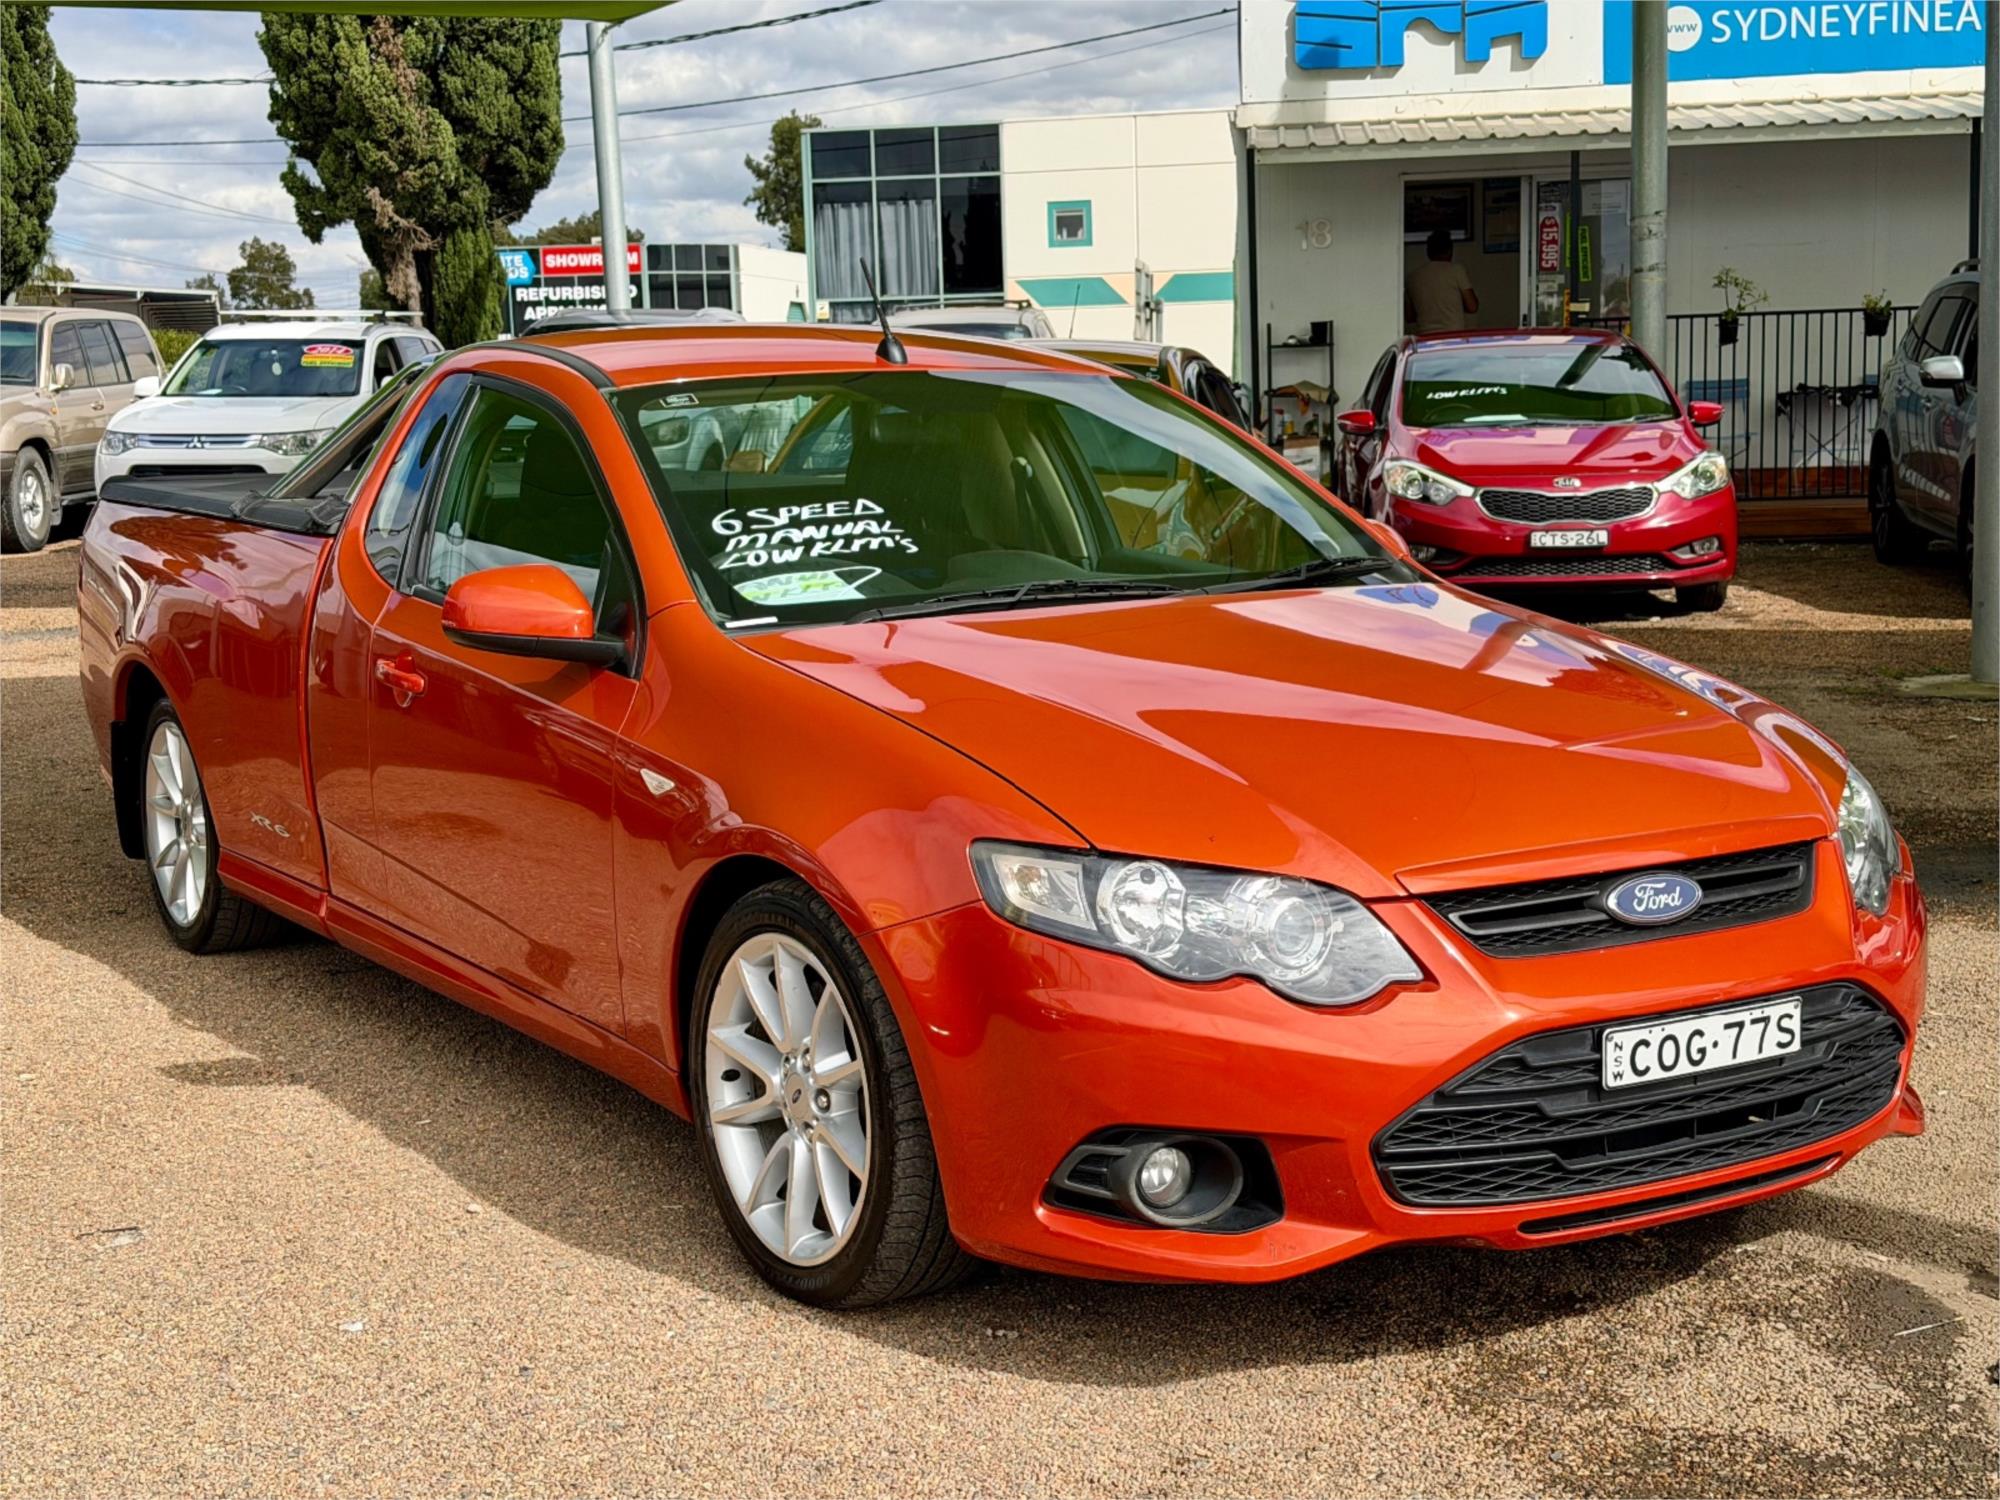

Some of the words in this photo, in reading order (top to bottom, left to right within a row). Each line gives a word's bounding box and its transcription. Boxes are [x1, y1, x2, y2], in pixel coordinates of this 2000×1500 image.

[545, 252, 638, 268] SHOWRM
[516, 284, 637, 301] REFURBISD
[712, 509, 743, 535] 6
[746, 499, 884, 529] SPEED
[719, 545, 804, 570] LOW
[1633, 882, 1682, 912] Ford
